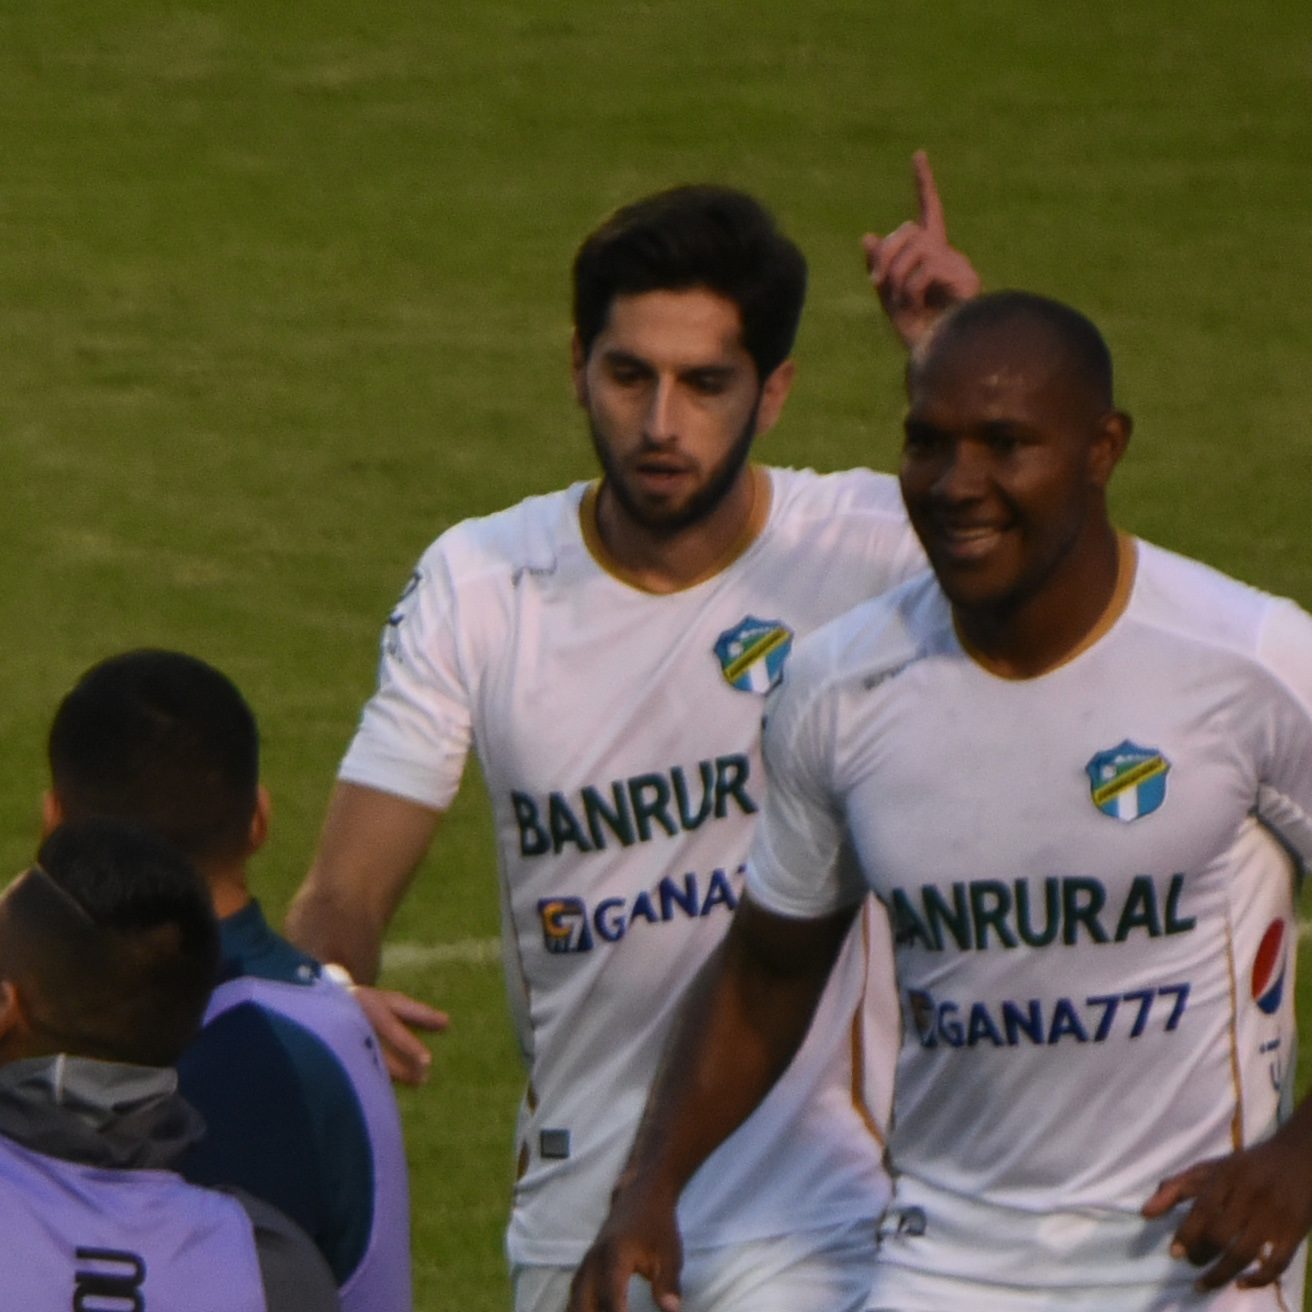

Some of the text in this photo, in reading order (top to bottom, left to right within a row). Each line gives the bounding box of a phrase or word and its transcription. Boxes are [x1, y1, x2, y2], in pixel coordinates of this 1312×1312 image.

[510, 753, 758, 857] BANRUR
[594, 863, 747, 942] GANA
[888, 872, 1198, 951] ANRURAL
[938, 982, 1192, 1047] GANA777
